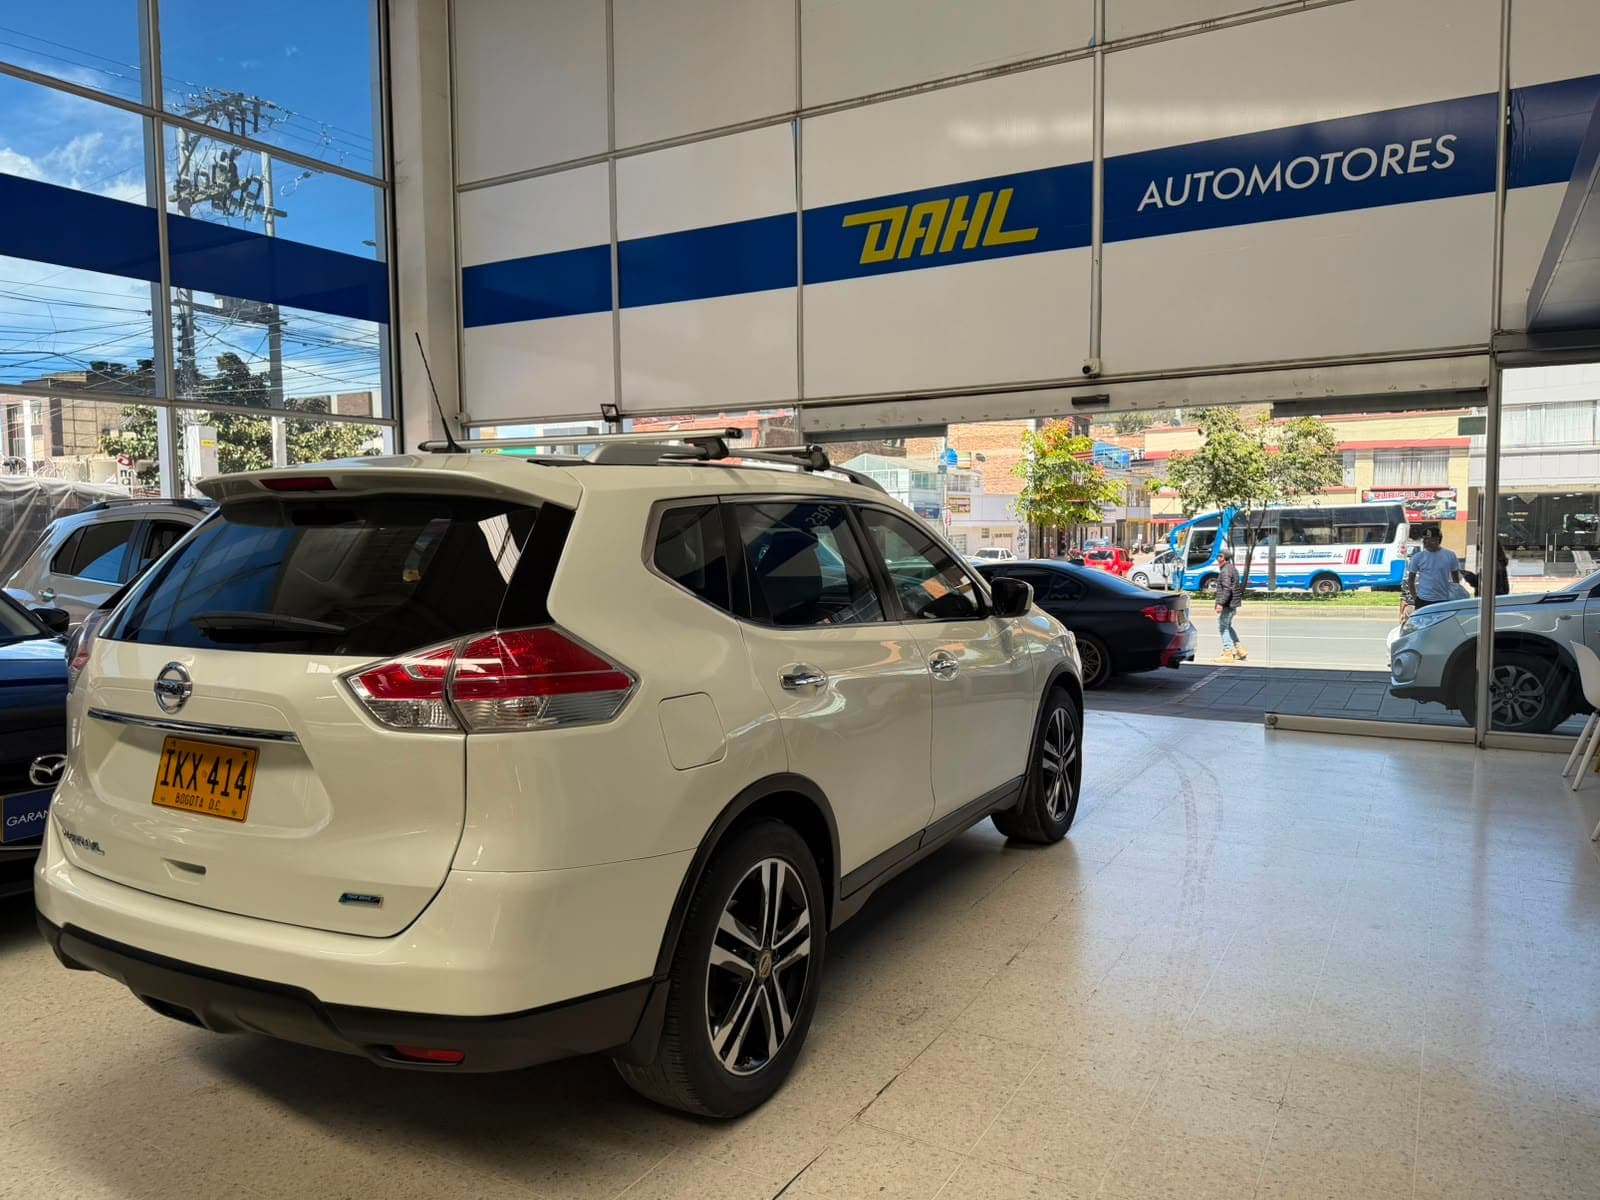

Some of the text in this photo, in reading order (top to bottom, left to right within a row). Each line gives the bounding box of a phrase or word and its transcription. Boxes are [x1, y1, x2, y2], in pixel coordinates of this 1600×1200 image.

[842, 134, 1457, 264] DAHL AUTOMOTORES
[160, 749, 248, 800] IKX 414
[175, 792, 204, 808] BOGOTA
